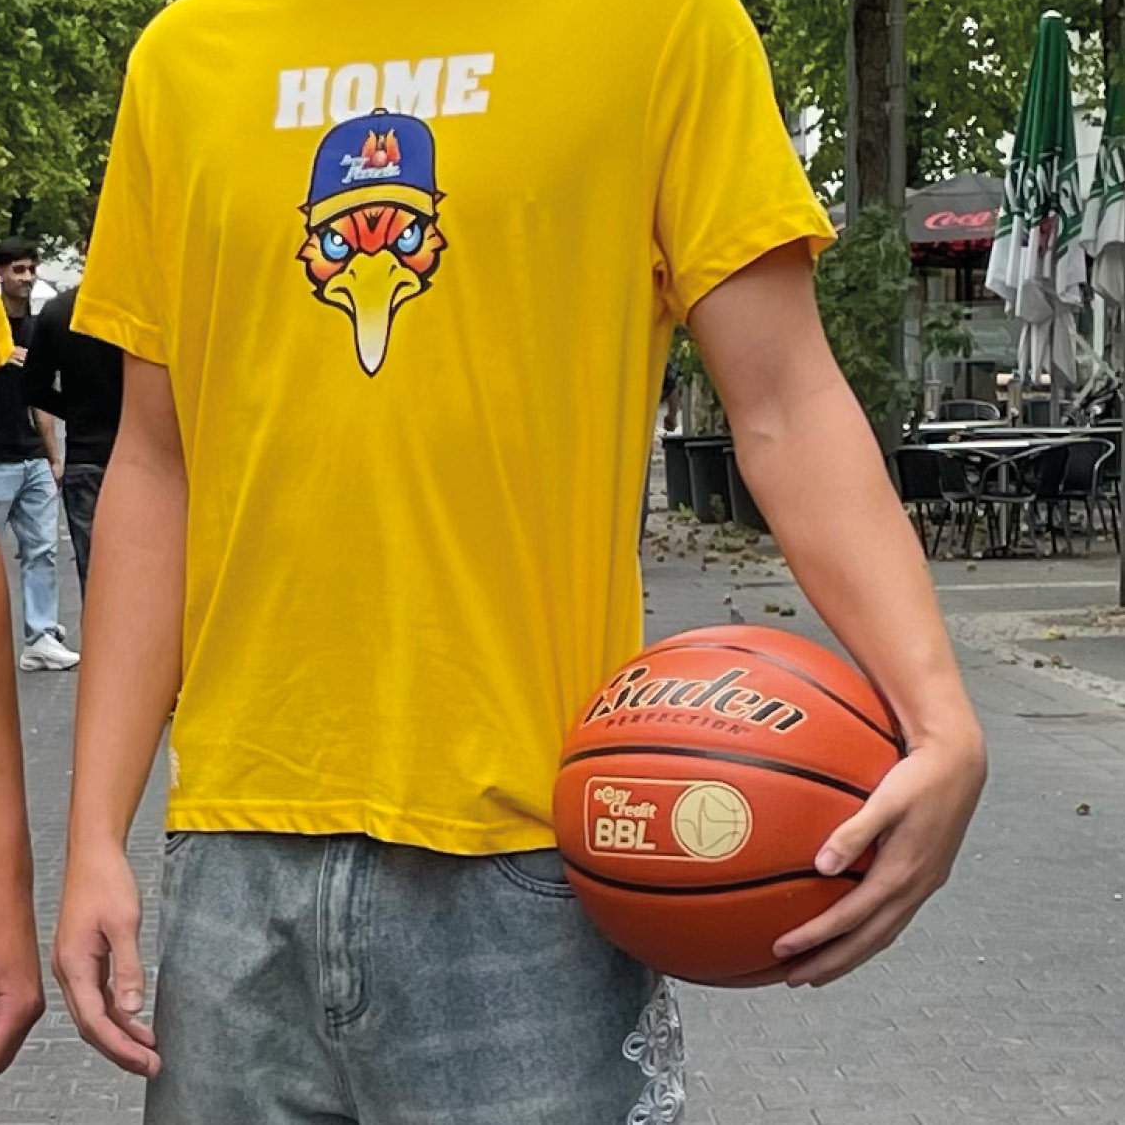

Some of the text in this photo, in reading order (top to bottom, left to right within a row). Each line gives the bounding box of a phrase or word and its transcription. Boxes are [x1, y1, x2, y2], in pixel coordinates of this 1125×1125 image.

[273, 52, 495, 130] HOME
[580, 664, 809, 735] Baden
[595, 817, 657, 851] BBL
